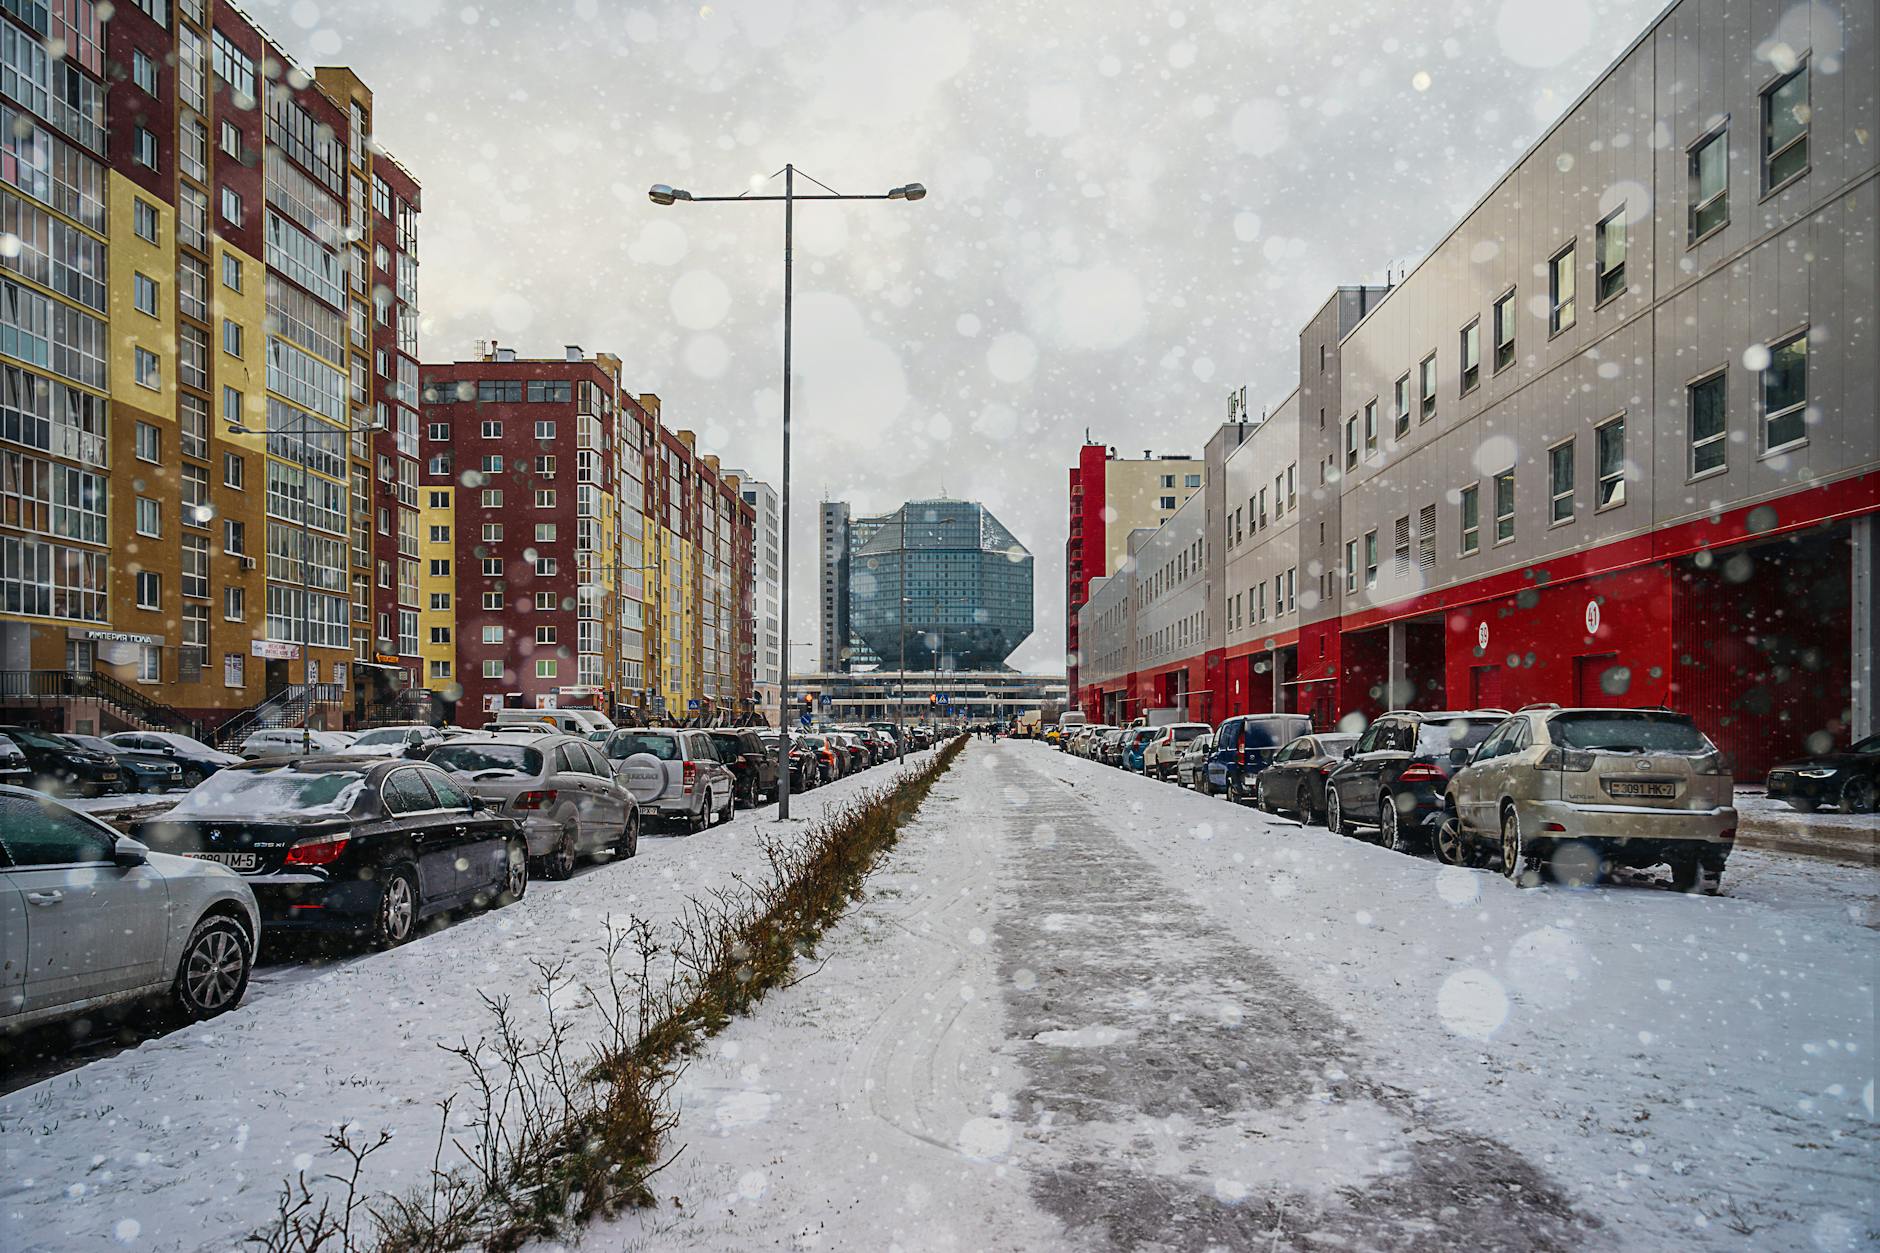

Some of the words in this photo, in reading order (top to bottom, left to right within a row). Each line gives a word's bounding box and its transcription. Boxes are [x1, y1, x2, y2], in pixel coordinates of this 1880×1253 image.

[1588, 606, 1598, 627] 41
[88, 631, 128, 642] ИМПЕРИЯ
[130, 634, 152, 644] ПОЛА
[1480, 626, 1488, 644] 39
